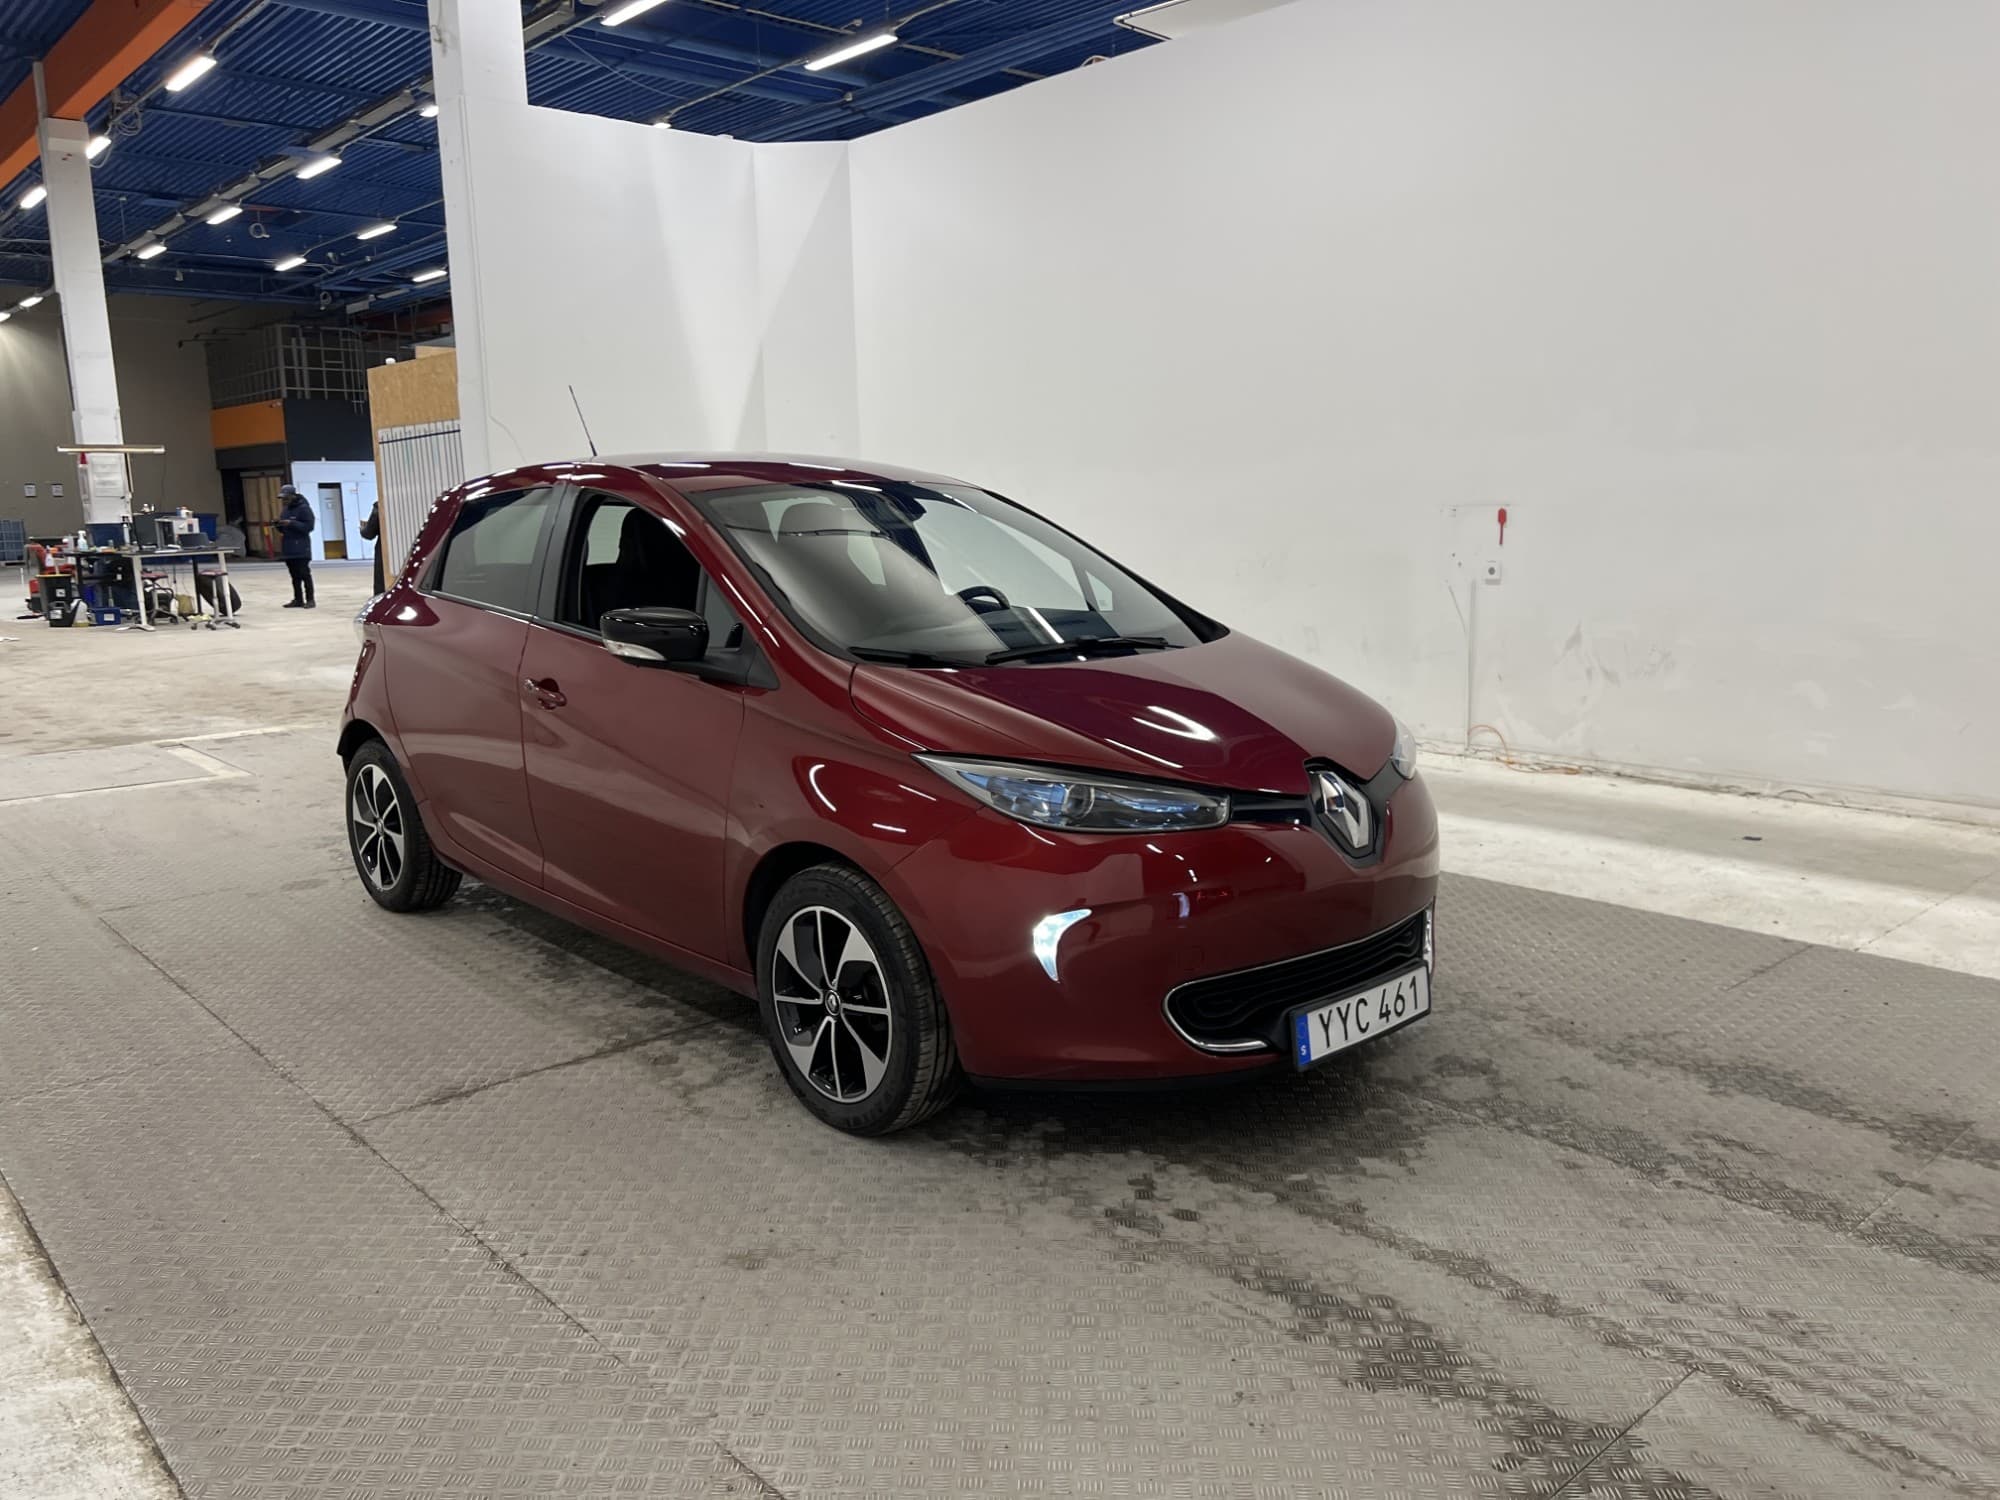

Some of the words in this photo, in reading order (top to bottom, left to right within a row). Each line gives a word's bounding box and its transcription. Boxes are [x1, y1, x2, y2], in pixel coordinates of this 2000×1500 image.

[1318, 998, 1370, 1048] YYC
[1379, 975, 1418, 1023] 461
[1300, 1045, 1307, 1056] S
